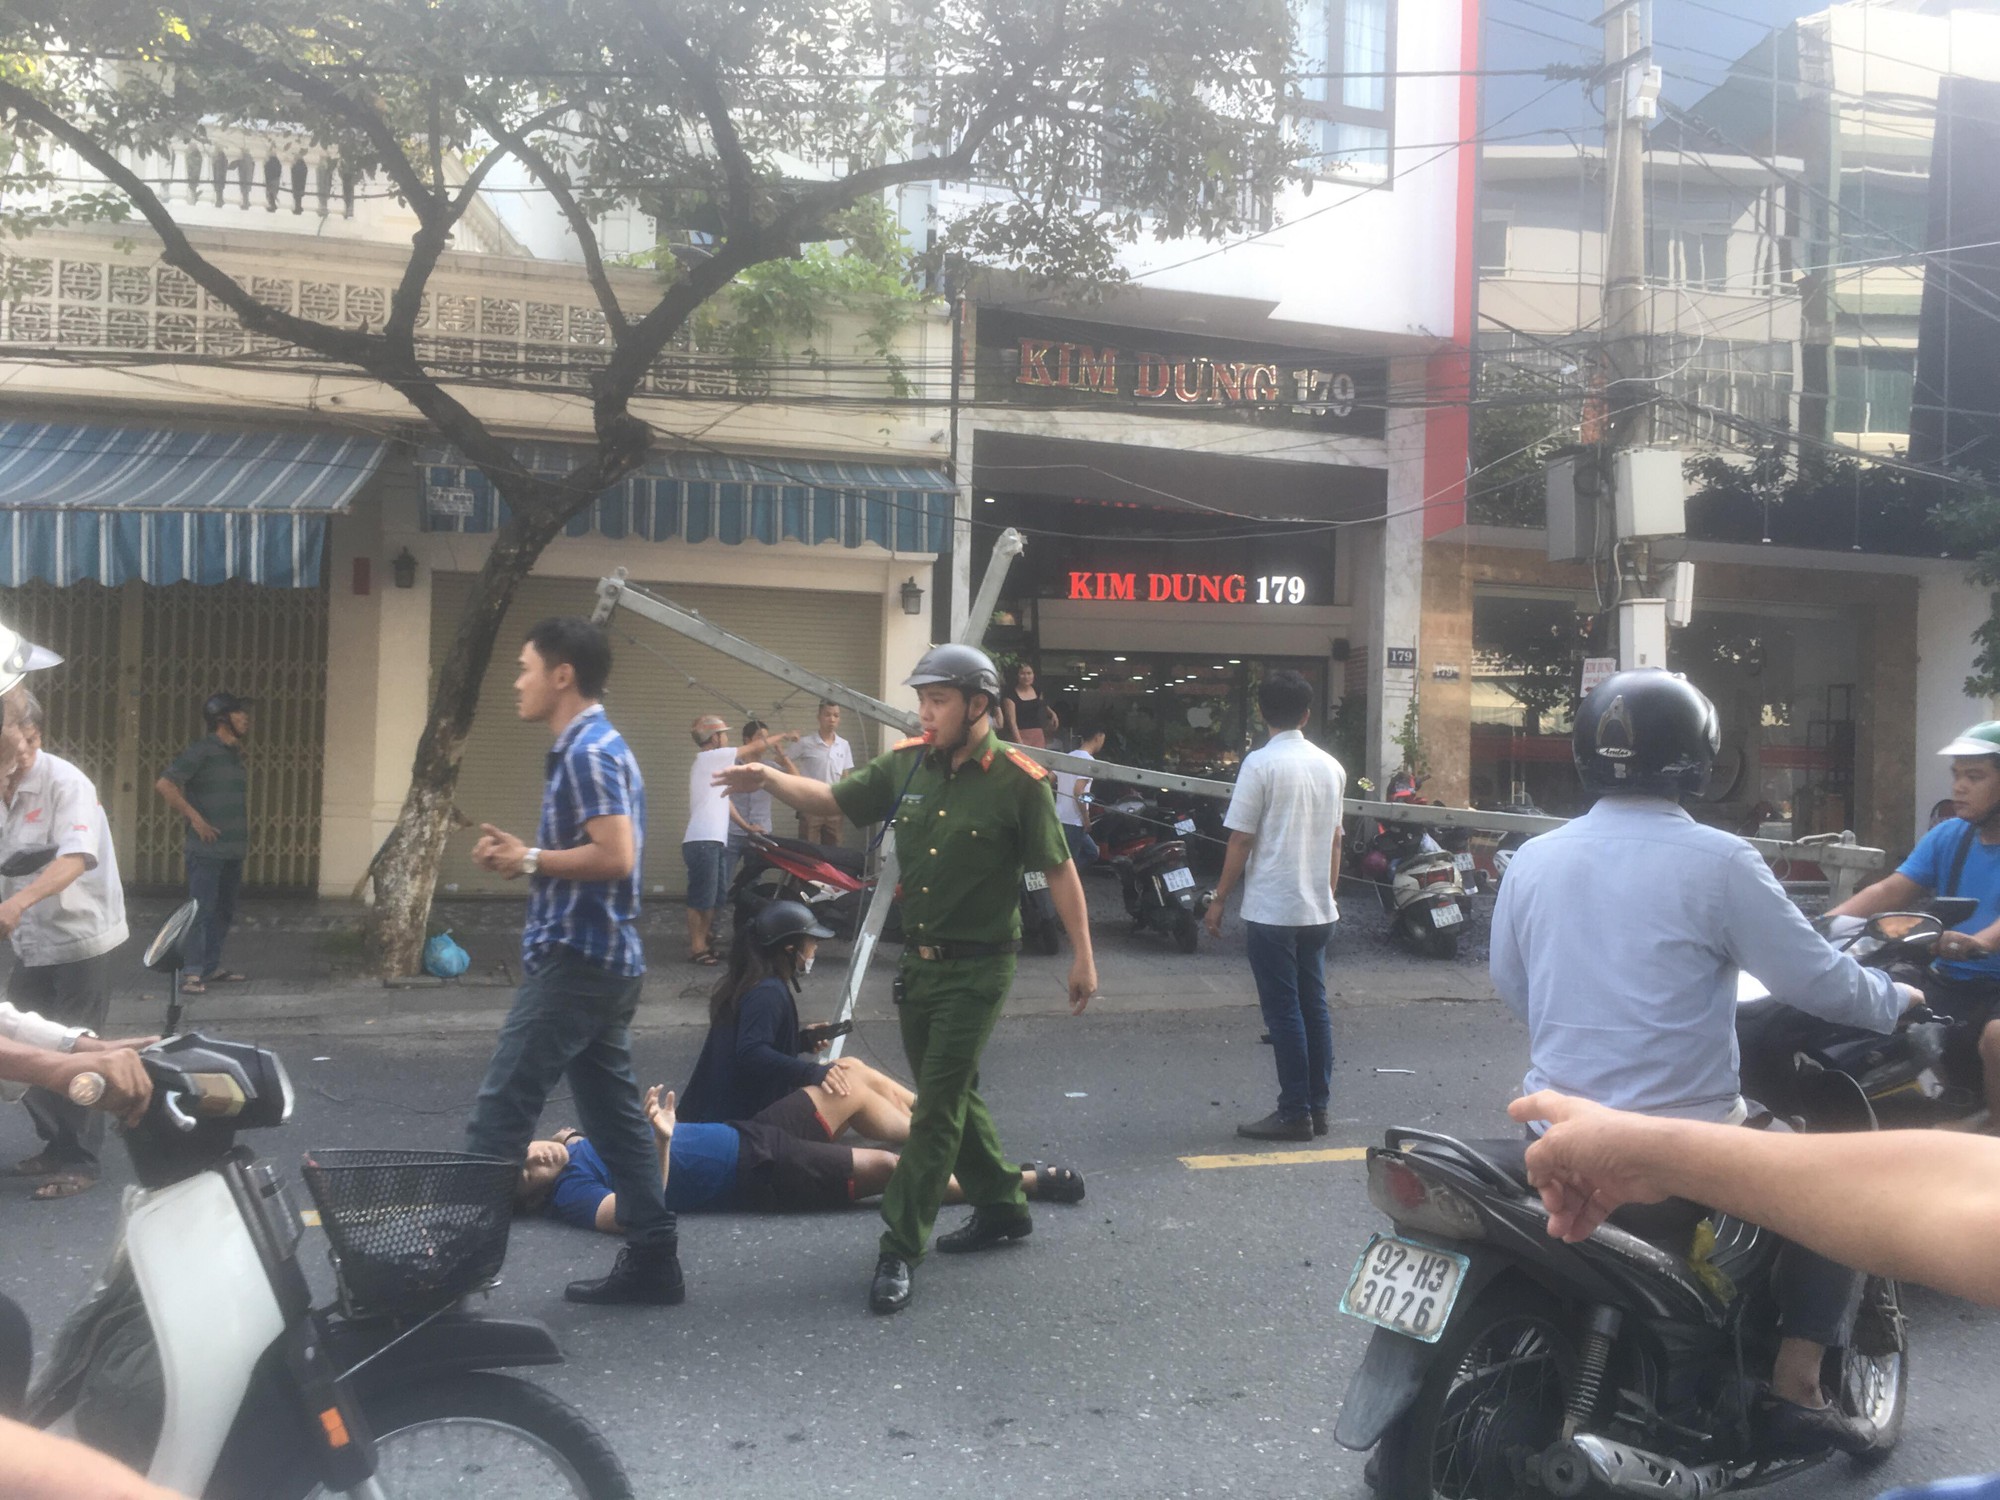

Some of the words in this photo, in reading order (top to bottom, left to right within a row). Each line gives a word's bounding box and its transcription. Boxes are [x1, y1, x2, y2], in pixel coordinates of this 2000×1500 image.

[1015, 337, 1119, 394] KIM
[1133, 351, 1279, 410] DUNG
[1291, 368, 1355, 418] 179
[1067, 571, 1137, 600] KIM
[1147, 573, 1247, 603] DUNG
[1256, 576, 1306, 604] 179
[1391, 650, 1413, 662] 179
[1356, 1279, 1435, 1331] 3026
